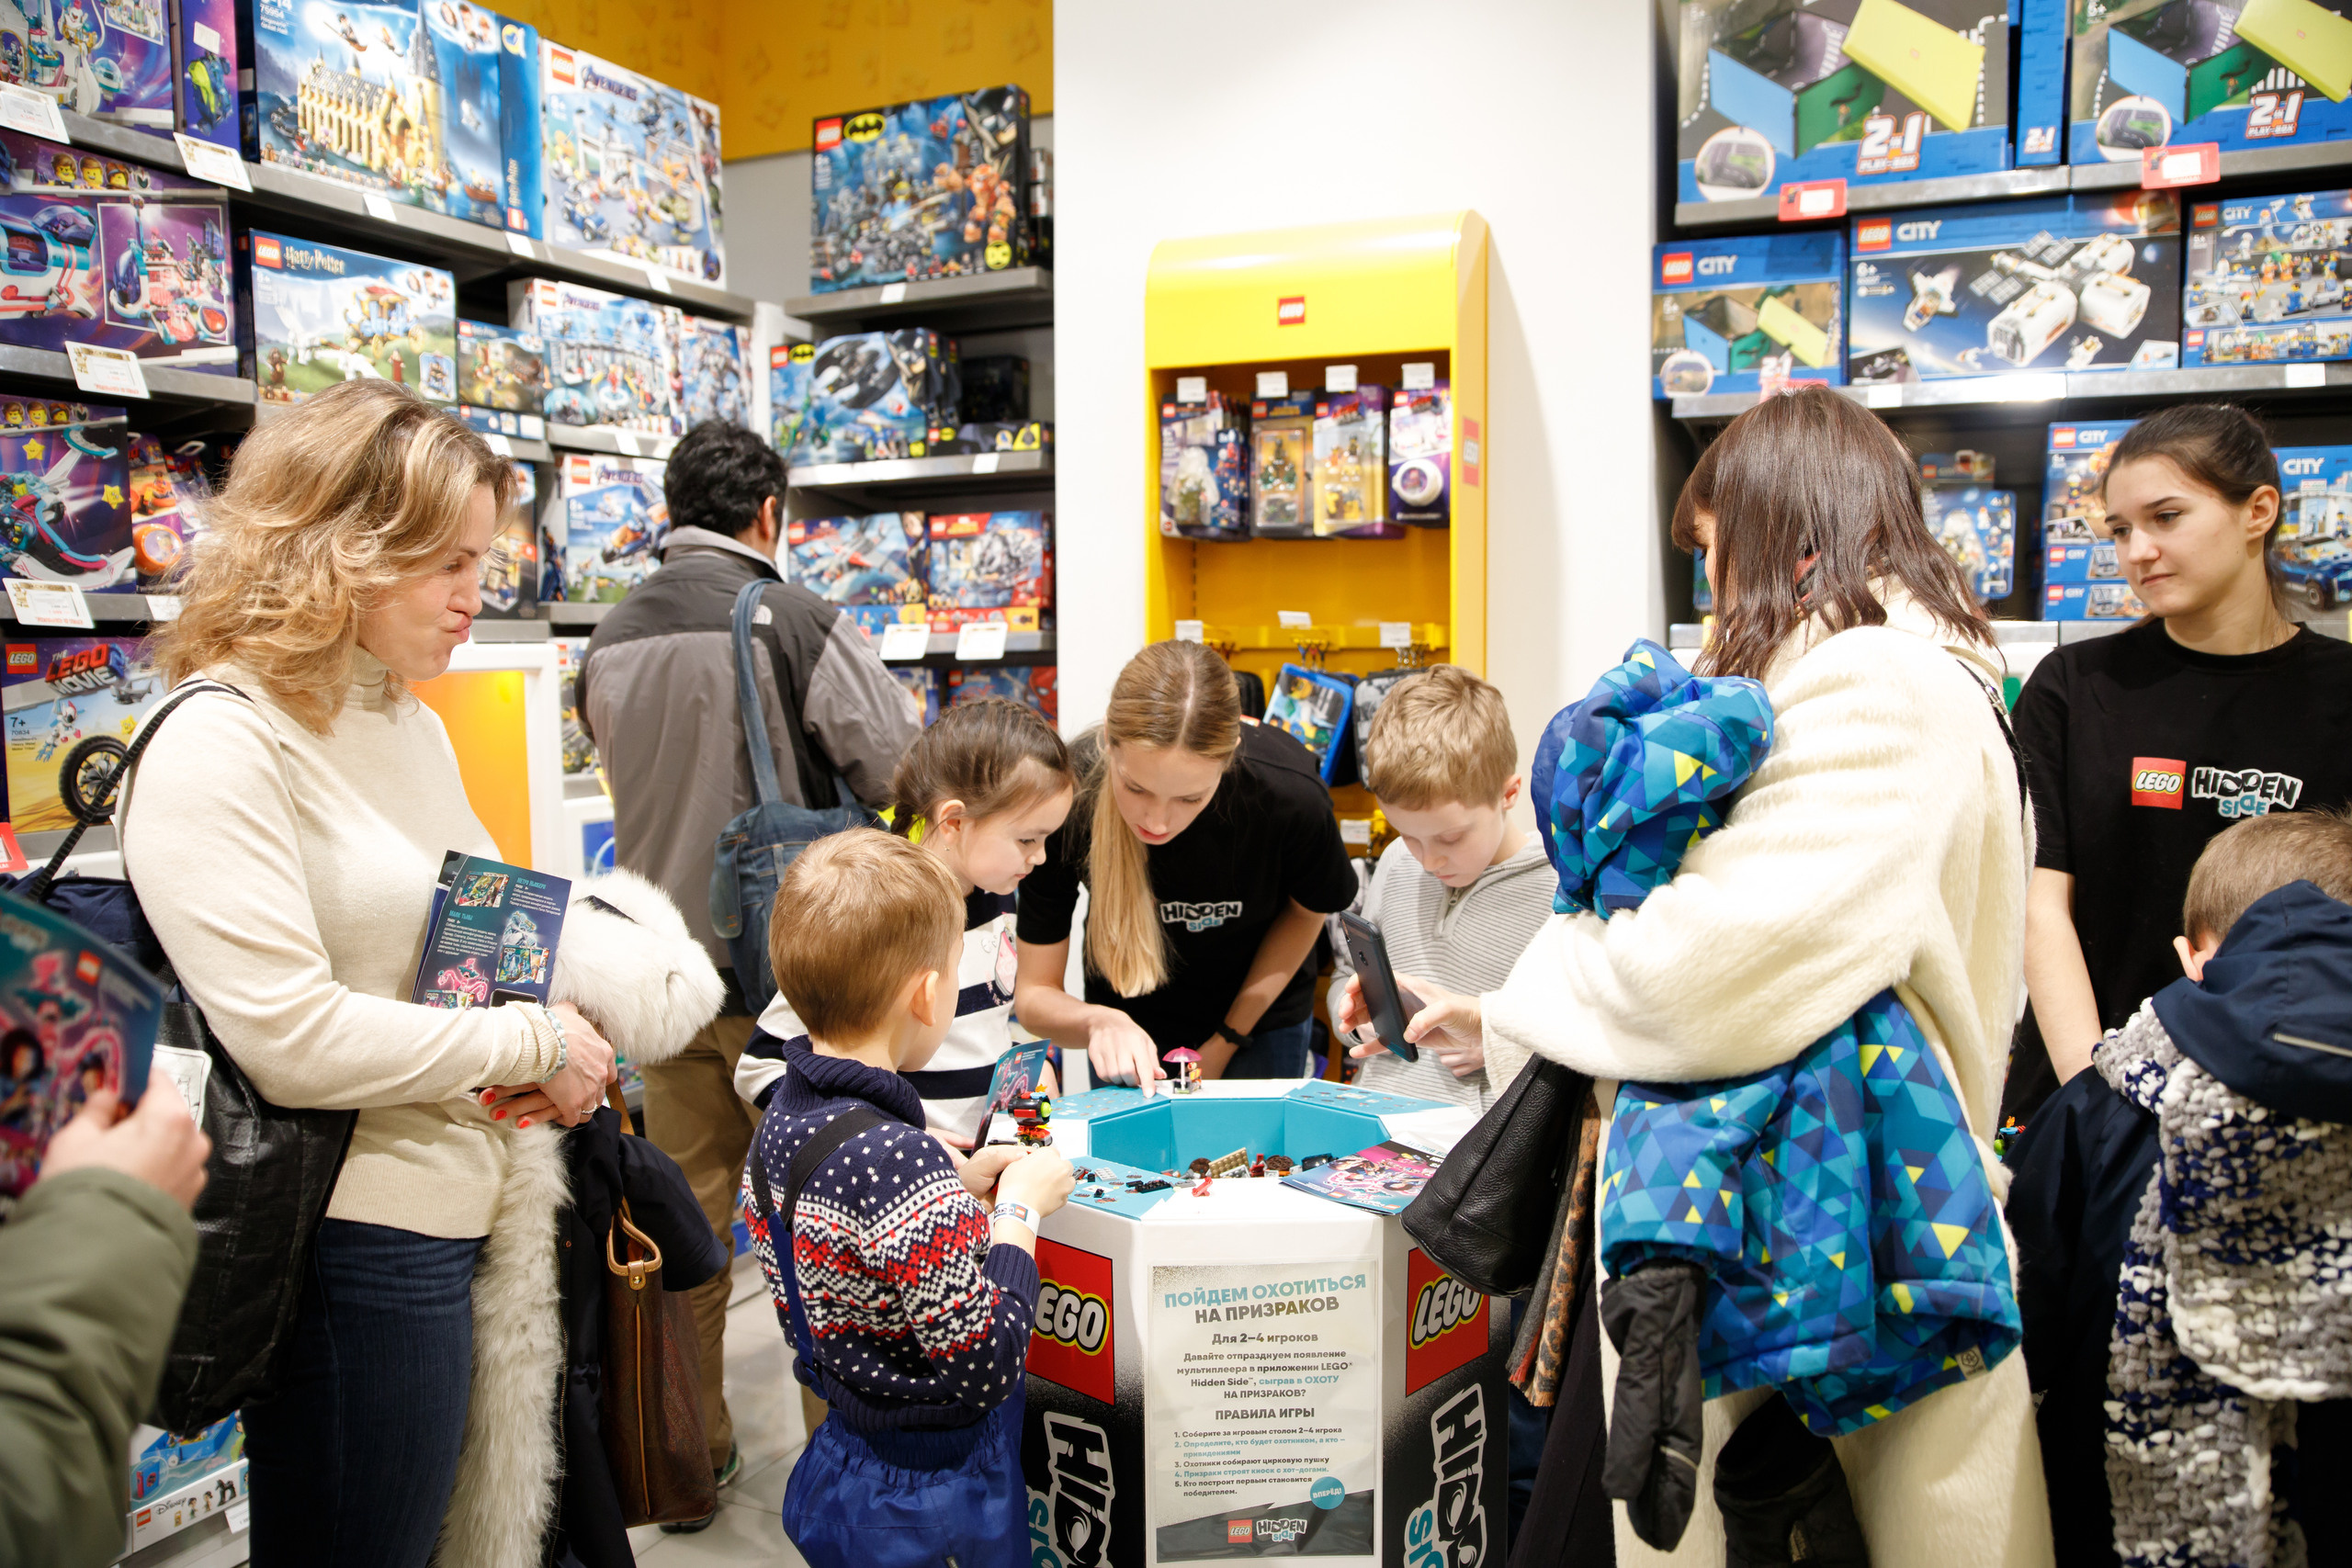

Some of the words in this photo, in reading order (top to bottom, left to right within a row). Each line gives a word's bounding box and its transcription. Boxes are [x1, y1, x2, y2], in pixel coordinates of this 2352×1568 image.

[2249, 94, 2278, 128] 2
[2282, 91, 2303, 123] 1
[1860, 118, 1894, 158] 2
[1902, 113, 1924, 153] 1
[2222, 206, 2254, 220] CITY
[1858, 226, 1891, 244] LEGO
[1896, 220, 1943, 242] CITY
[257, 245, 279, 260] LEGO
[284, 245, 314, 271] Harry
[313, 249, 347, 276] Potter
[1662, 260, 1691, 276] LEGO
[1696, 254, 1738, 276] CITY
[1279, 303, 1305, 318] LEGO
[2077, 429, 2109, 444] CITY
[1463, 439, 1478, 465] LEGO
[2283, 457, 2325, 475] CITY
[7, 651, 36, 665] LEGO
[45, 643, 109, 682] LEGO
[51, 649, 68, 661] THE
[49, 665, 117, 695] MOVIE
[10, 716, 26, 728] 7+
[2135, 771, 2182, 794] LEGO
[2192, 768, 2303, 808] HIDDEN
[2221, 794, 2267, 817] SIDE
[1160, 901, 1242, 922] HIDDEN
[1188, 917, 1223, 931] SIDE
[1164, 1286, 1249, 1309] ПОЙДЕМ
[1251, 1273, 1366, 1300] ОХОТИТЬСЯ
[1033, 1284, 1106, 1350] EGO
[1194, 1308, 1222, 1324] НА
[1225, 1296, 1340, 1322] ПРИЗРАКОВ
[1211, 1333, 1238, 1346] Для
[1267, 1333, 1319, 1346] игроков
[1183, 1352, 1225, 1363] Давайте
[1227, 1351, 1292, 1362] отпразднуем
[1293, 1350, 1347, 1359] появление
[1177, 1364, 1248, 1376] мультиплеера
[1257, 1363, 1319, 1373] приложении
[1191, 1377, 1226, 1387] Hidden
[1259, 1377, 1295, 1386] сыграв
[1305, 1375, 1340, 1384] ОХОТУ
[1224, 1391, 1238, 1399] НА
[1239, 1389, 1306, 1399] ПРИЗРАКОВ?
[1215, 1408, 1277, 1420] ПРАВИЛА
[1279, 1407, 1315, 1418] ИГРЫ
[1182, 1430, 1222, 1438] Соберите
[1232, 1428, 1268, 1438] игровым
[1315, 1427, 1342, 1435] игрока
[1183, 1438, 1234, 1449] Определите,
[1250, 1437, 1272, 1447] будет
[1273, 1437, 1318, 1445] охотником,
[1183, 1449, 1241, 1459] привидениями
[1183, 1460, 1221, 1468] Охотники
[1222, 1457, 1261, 1467] собирают
[1262, 1456, 1303, 1465] цирковую
[1304, 1456, 1330, 1464] пушку
[1183, 1469, 1222, 1478] Призраки
[1223, 1468, 1250, 1476] строят
[1198, 1479, 1235, 1487] построит
[1236, 1477, 1267, 1486] первым
[1183, 1489, 1238, 1497] победителем.
[153, 1497, 187, 1516] Disney
[1228, 1526, 1252, 1537] LEGO
[1257, 1518, 1307, 1535] HIDDEN
[1272, 1531, 1295, 1541] SIDE
